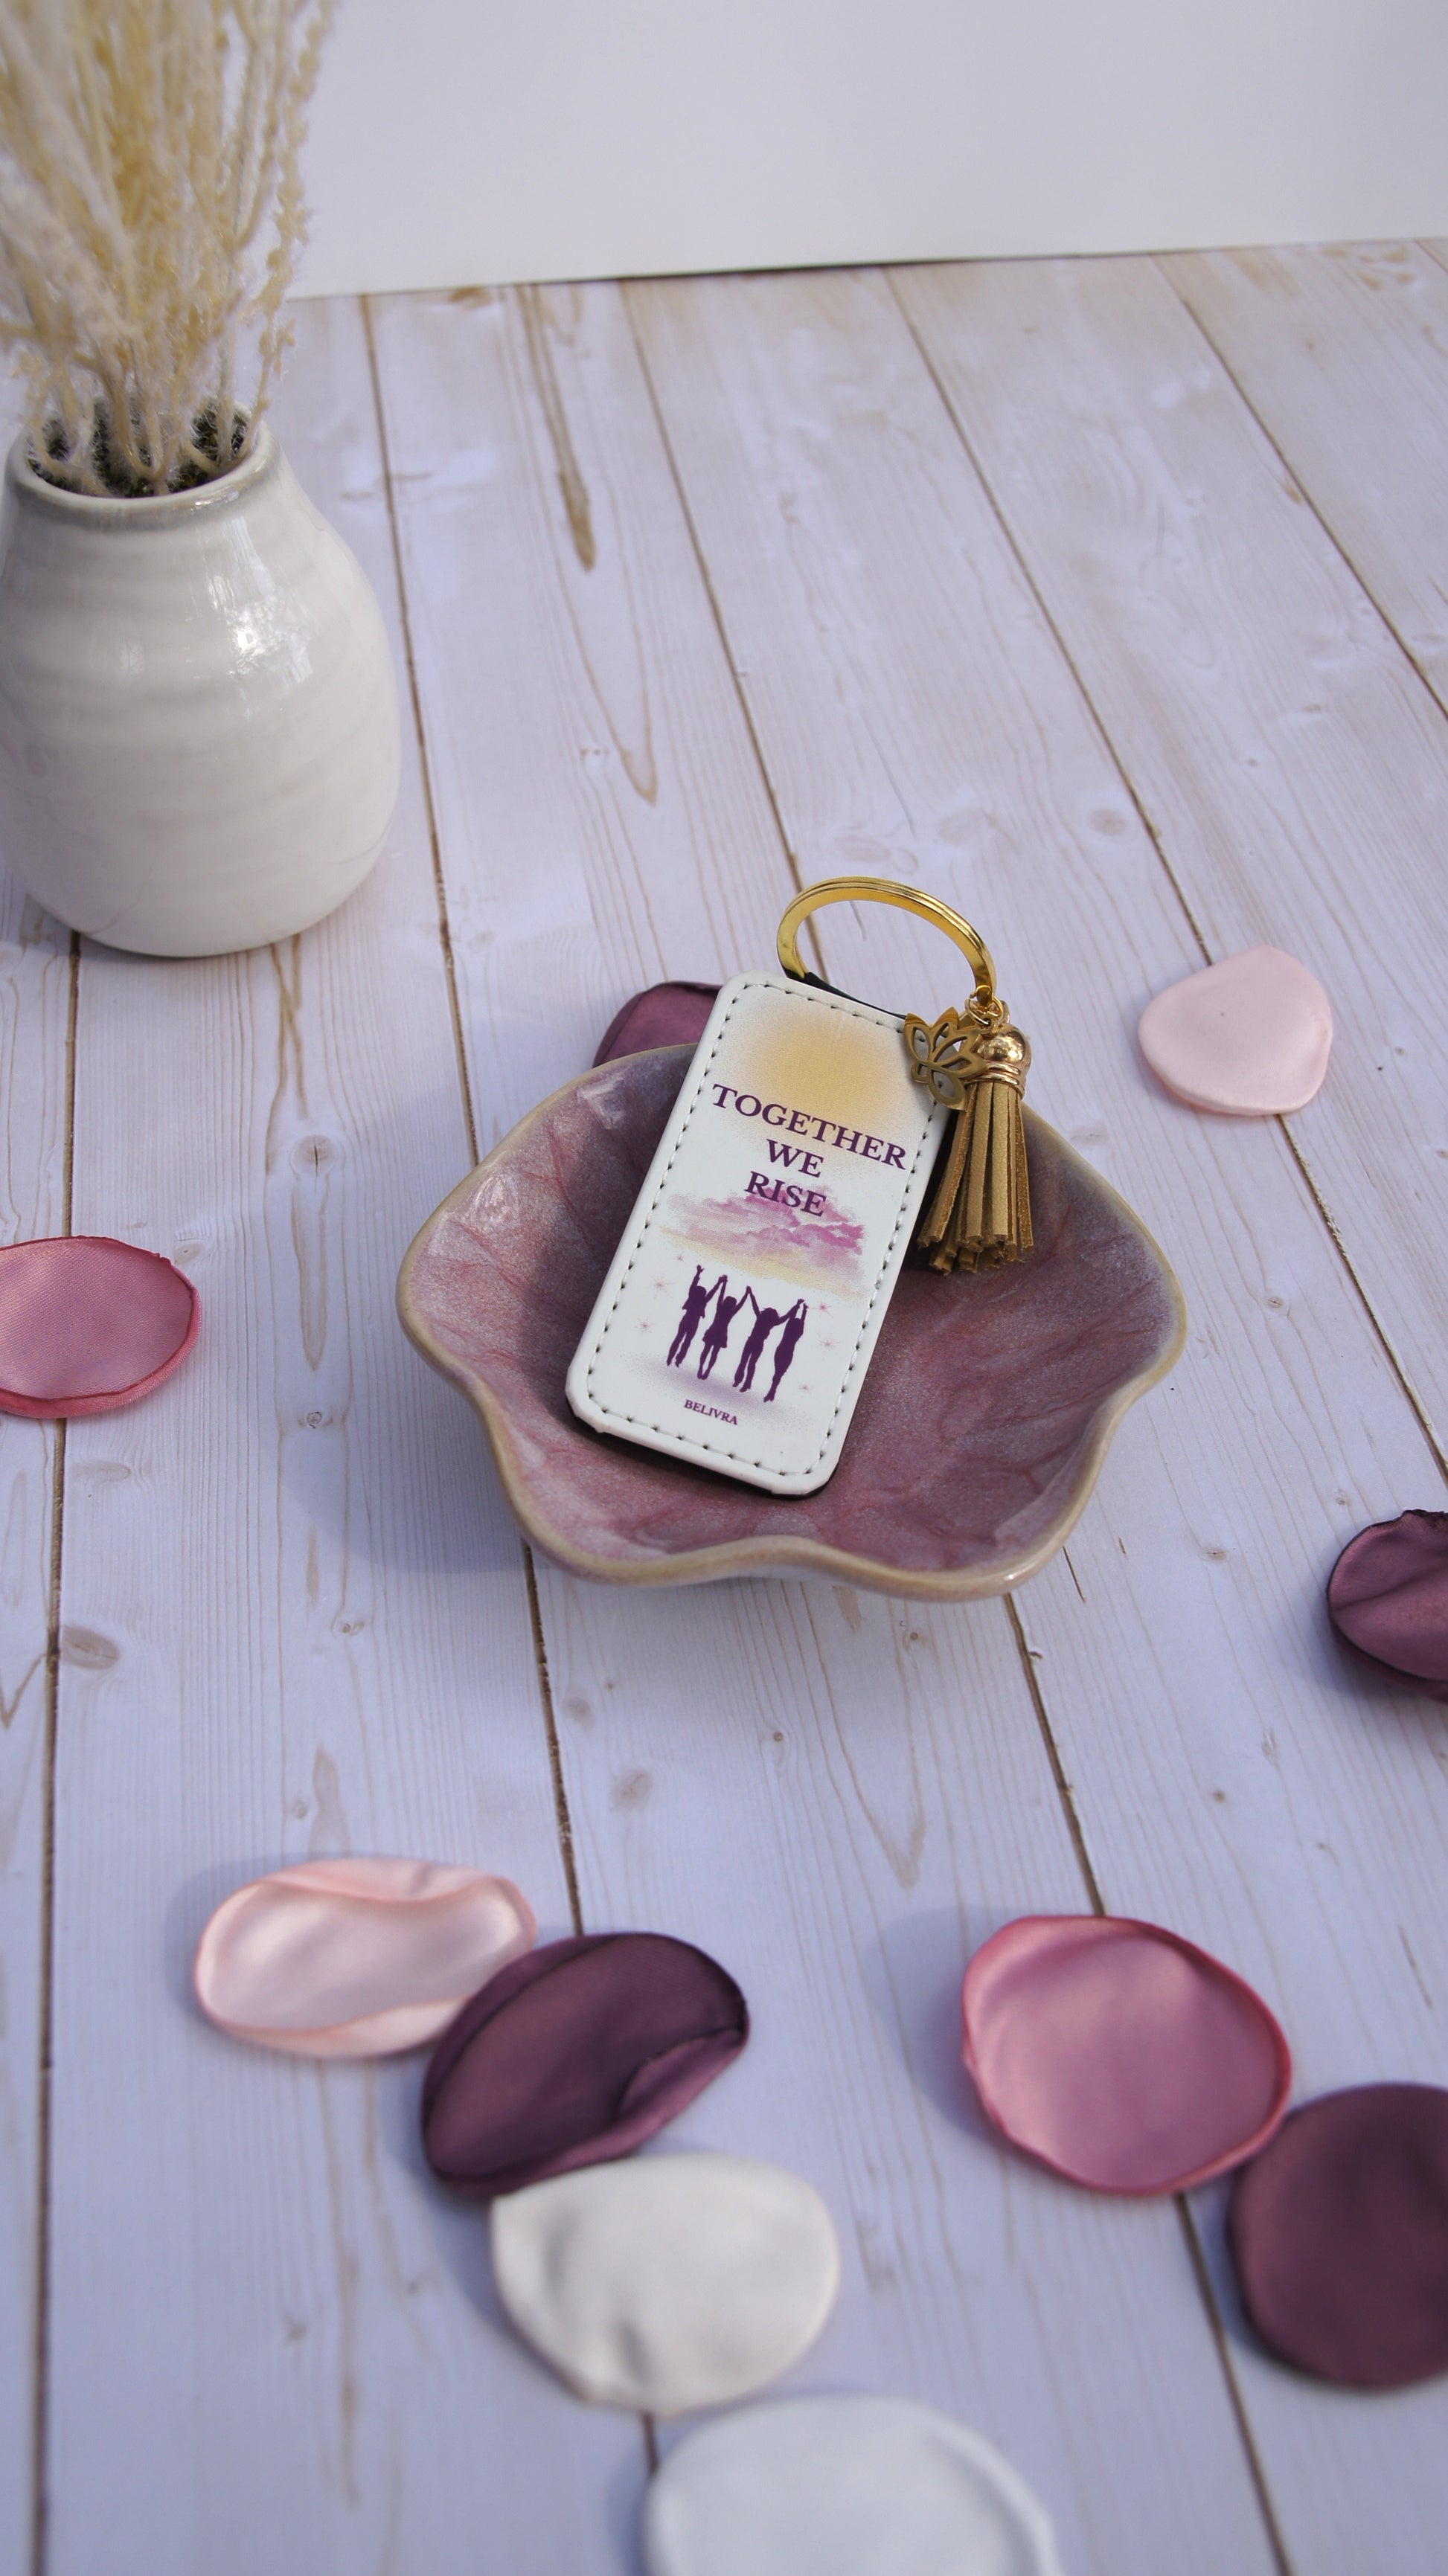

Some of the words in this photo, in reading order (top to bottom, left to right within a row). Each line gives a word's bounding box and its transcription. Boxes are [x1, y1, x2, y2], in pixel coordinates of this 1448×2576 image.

[712, 1084, 906, 1170] TOGETHER
[766, 1139, 824, 1178] WE
[744, 1171, 827, 1217] RISE
[684, 1399, 738, 1425] BELIVRA
